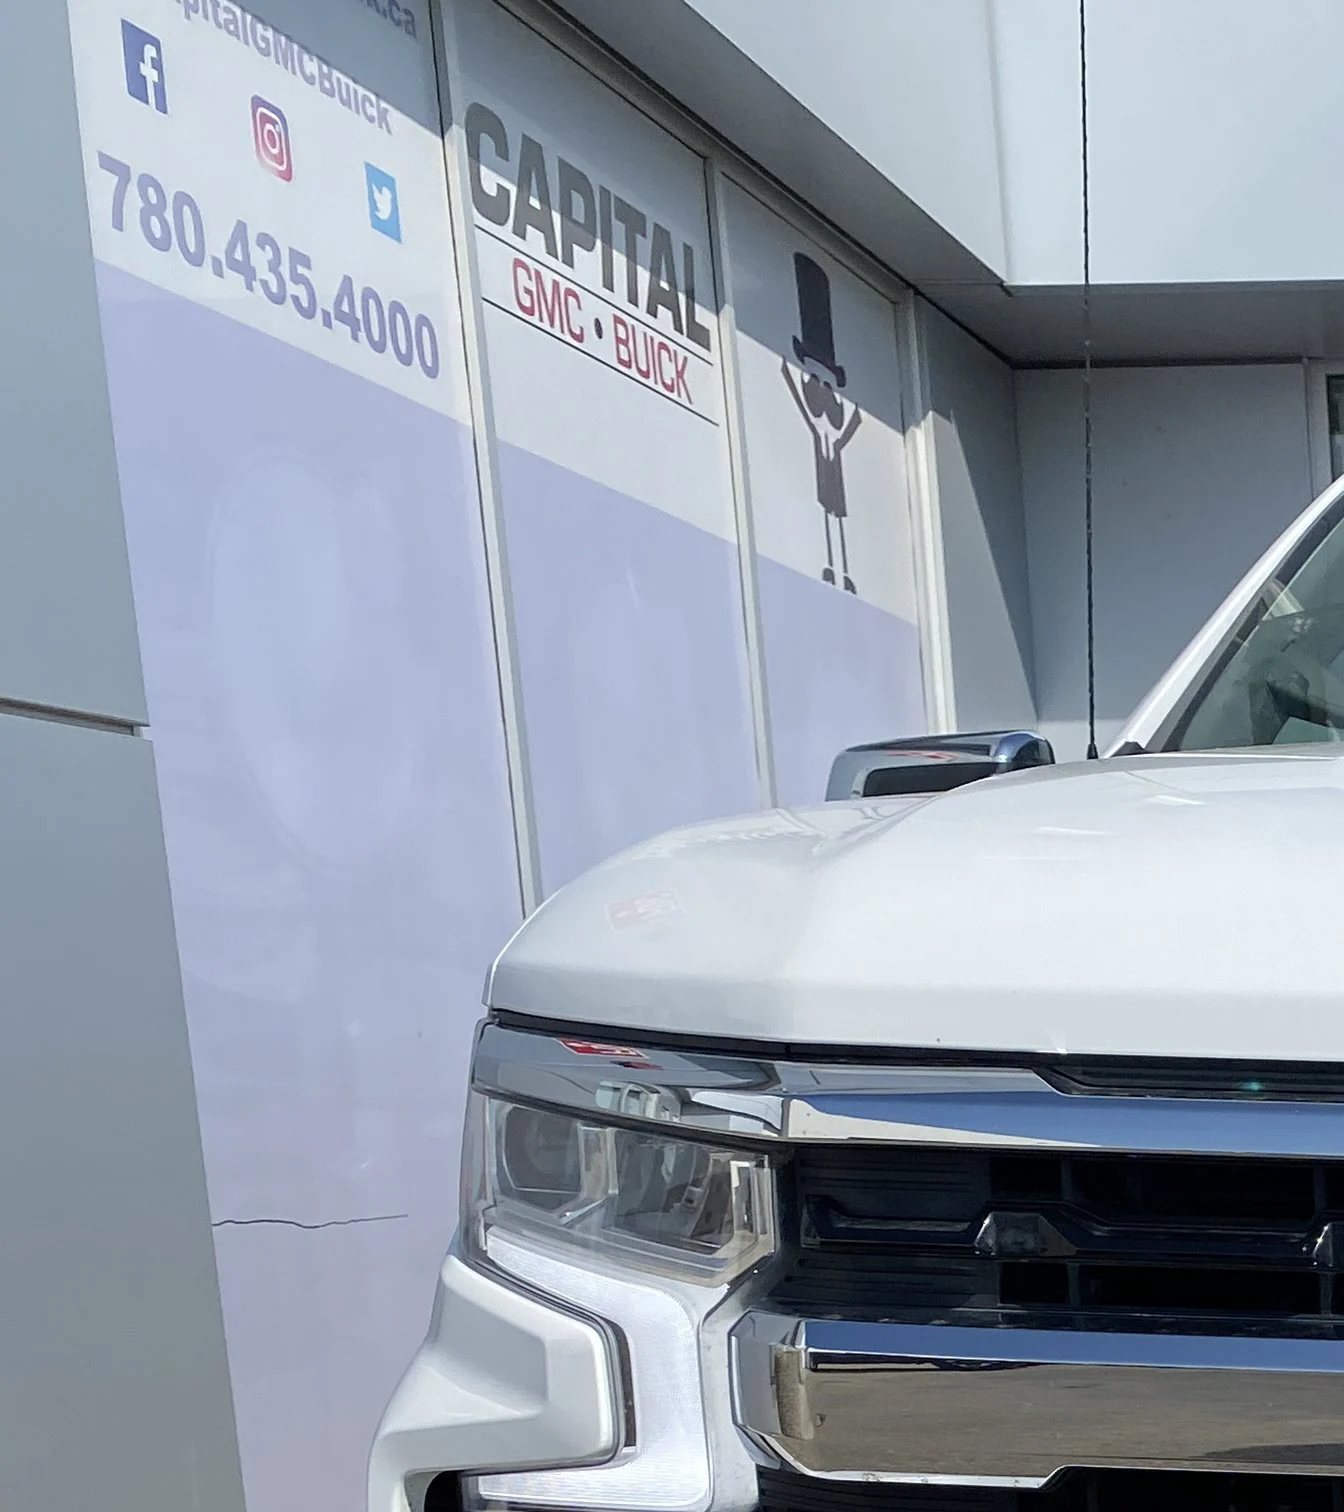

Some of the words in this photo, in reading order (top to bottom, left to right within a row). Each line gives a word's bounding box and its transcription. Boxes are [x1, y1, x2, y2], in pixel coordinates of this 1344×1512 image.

[176, 0, 393, 136] pitalGMCBuick
[97, 150, 440, 380] 780.435.4000
[464, 102, 711, 353] CAPITAL
[511, 257, 585, 344] GMC
[612, 313, 693, 405] BUICK
